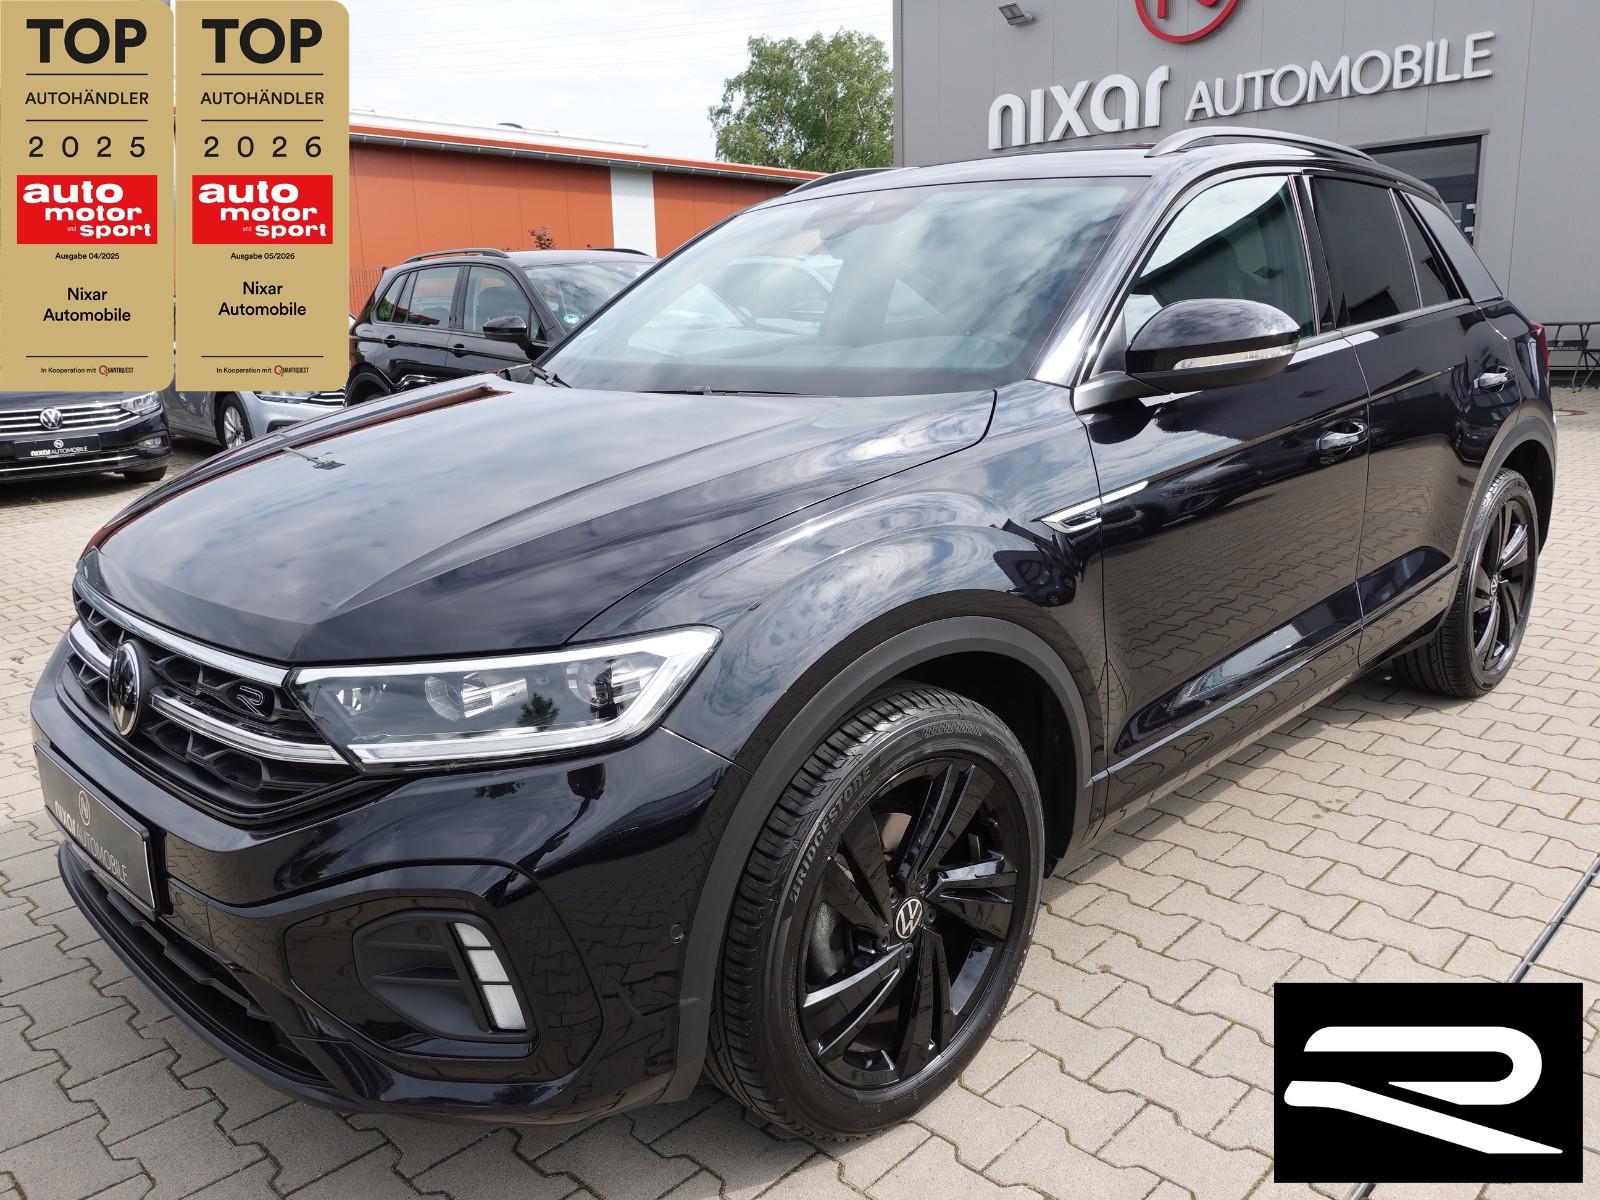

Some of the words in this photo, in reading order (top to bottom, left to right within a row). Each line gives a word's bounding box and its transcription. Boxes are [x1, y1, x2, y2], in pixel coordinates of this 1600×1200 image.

[988, 65, 1170, 149] nixar
[1184, 31, 1494, 122] AUTOMOBILE
[50, 446, 88, 455] AUTOMOBILE
[76, 824, 129, 886] AUTOMOBILE
[789, 765, 871, 904] BRIDGESTONE
